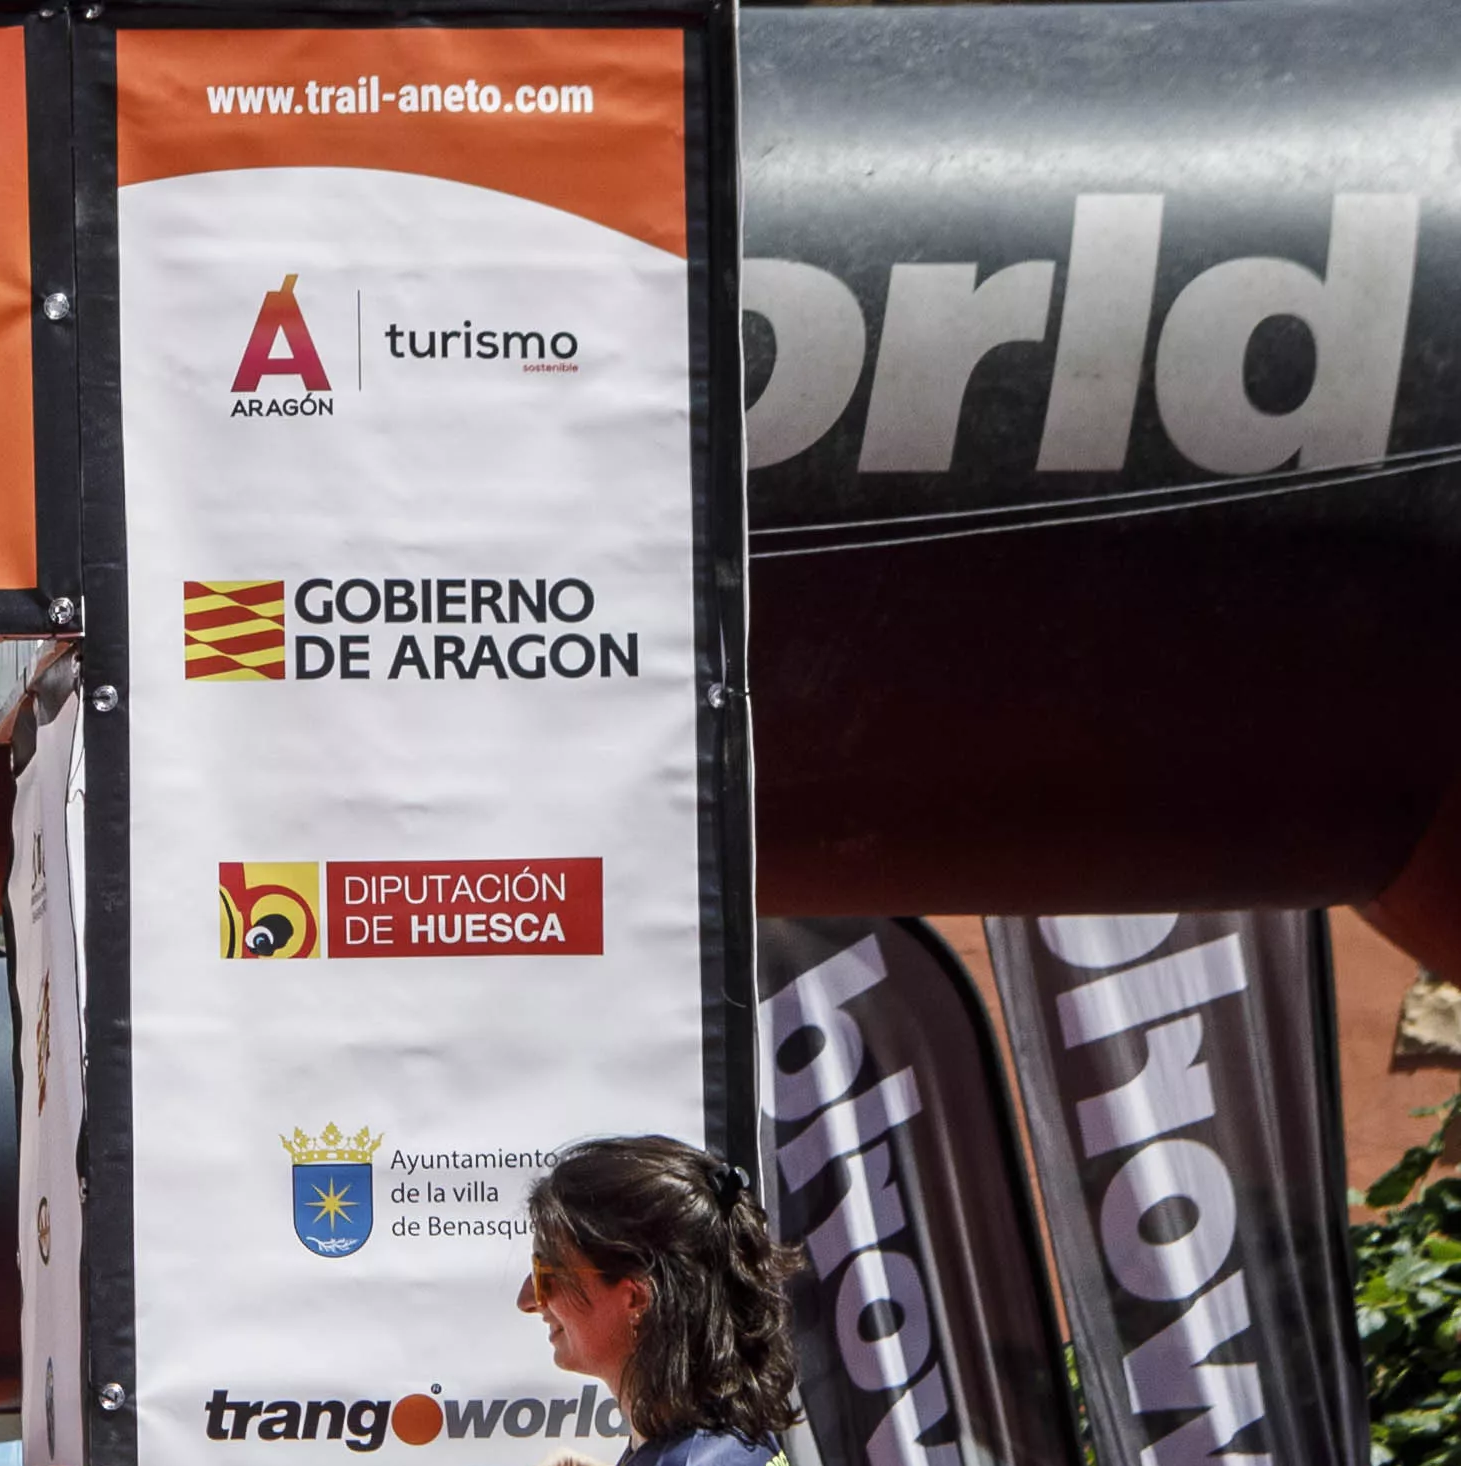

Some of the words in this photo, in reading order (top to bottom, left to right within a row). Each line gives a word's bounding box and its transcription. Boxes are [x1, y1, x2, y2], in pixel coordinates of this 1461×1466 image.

[206, 76, 595, 115] www.trail-aneto.com
[384, 321, 578, 360] turismo
[230, 392, 334, 417] ARAGÓN
[294, 577, 595, 623] GOBIERNO
[295, 635, 370, 681] DE
[388, 632, 639, 680] ARAGON
[343, 867, 566, 905] DIPUTACIÓN
[344, 915, 394, 945] DE
[410, 911, 566, 945] HUESCA
[390, 1149, 558, 1175] Ayuntamiento
[391, 1183, 419, 1203] de
[428, 1183, 445, 1203] la
[453, 1182, 499, 1203] villa
[392, 1217, 420, 1237] de
